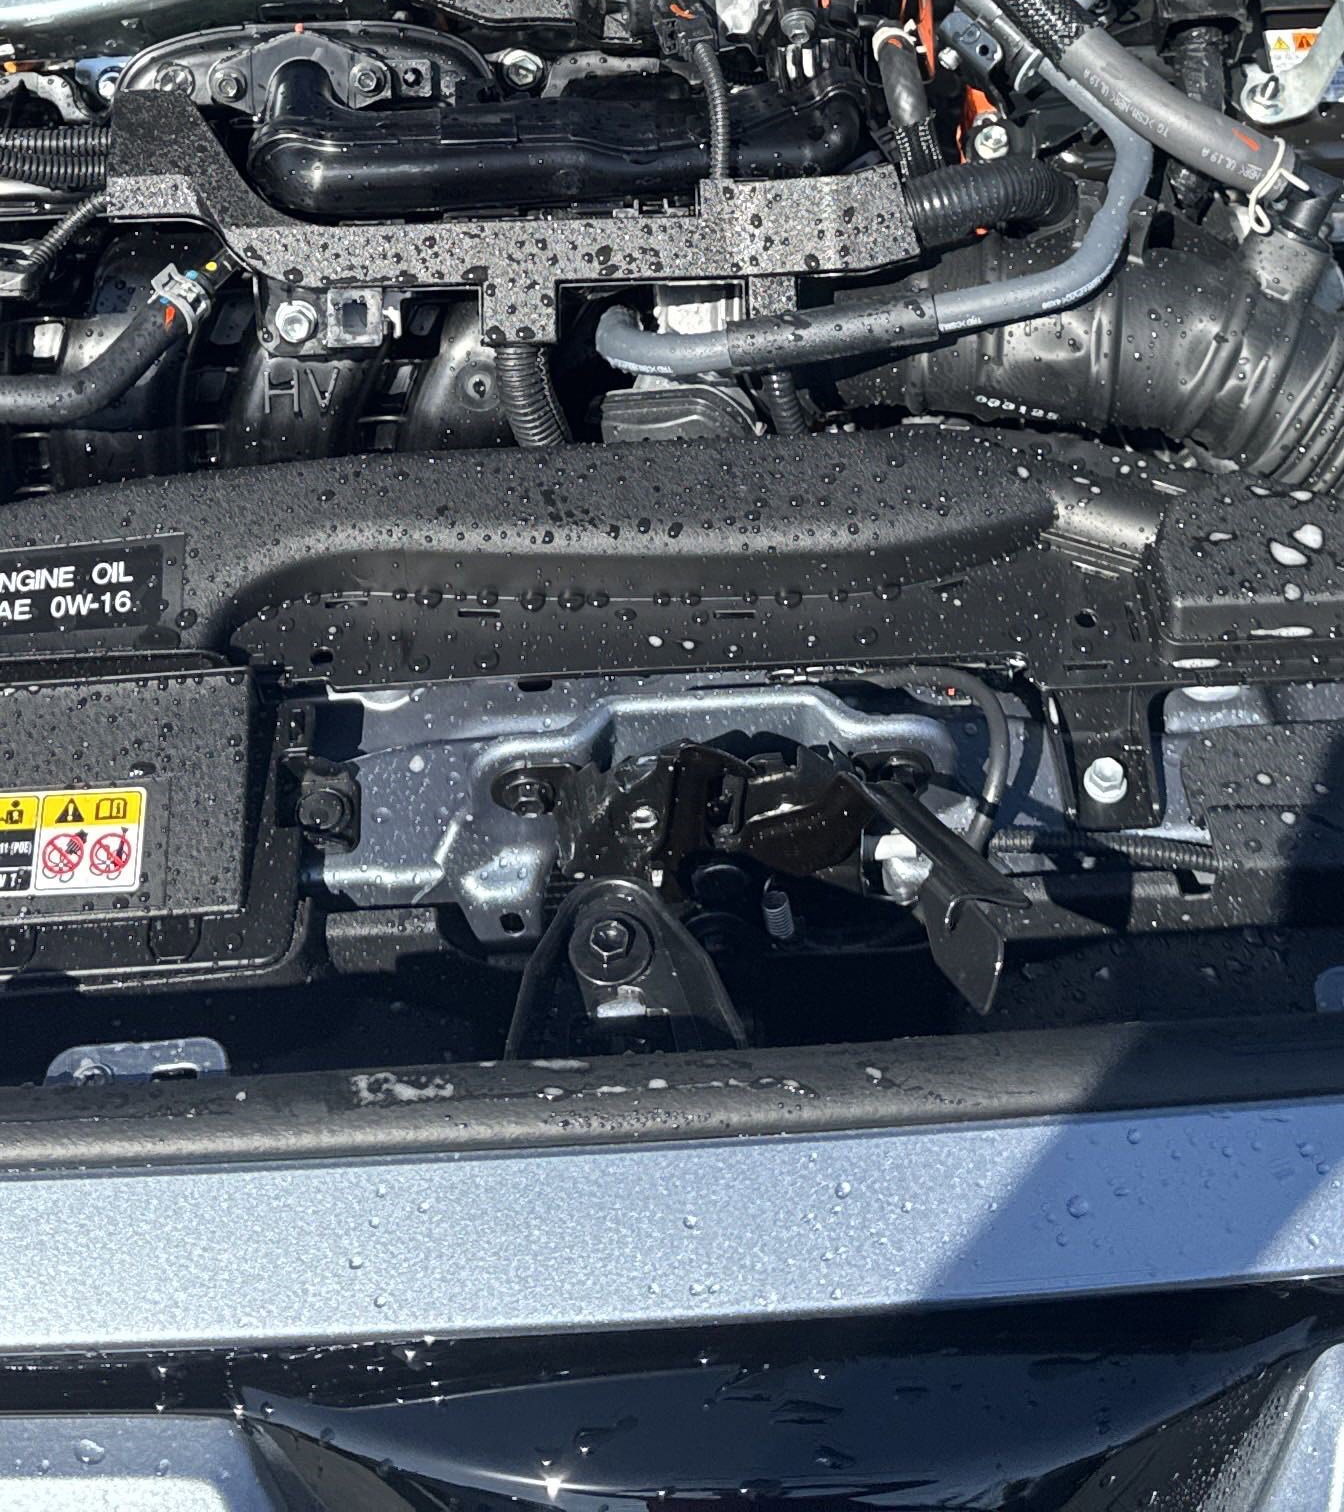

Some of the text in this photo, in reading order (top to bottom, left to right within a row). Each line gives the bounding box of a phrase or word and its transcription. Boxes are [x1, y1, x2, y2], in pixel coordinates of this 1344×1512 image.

[263, 367, 340, 415] HV
[91, 560, 134, 585] OIL
[50, 590, 132, 619] 0W-16
